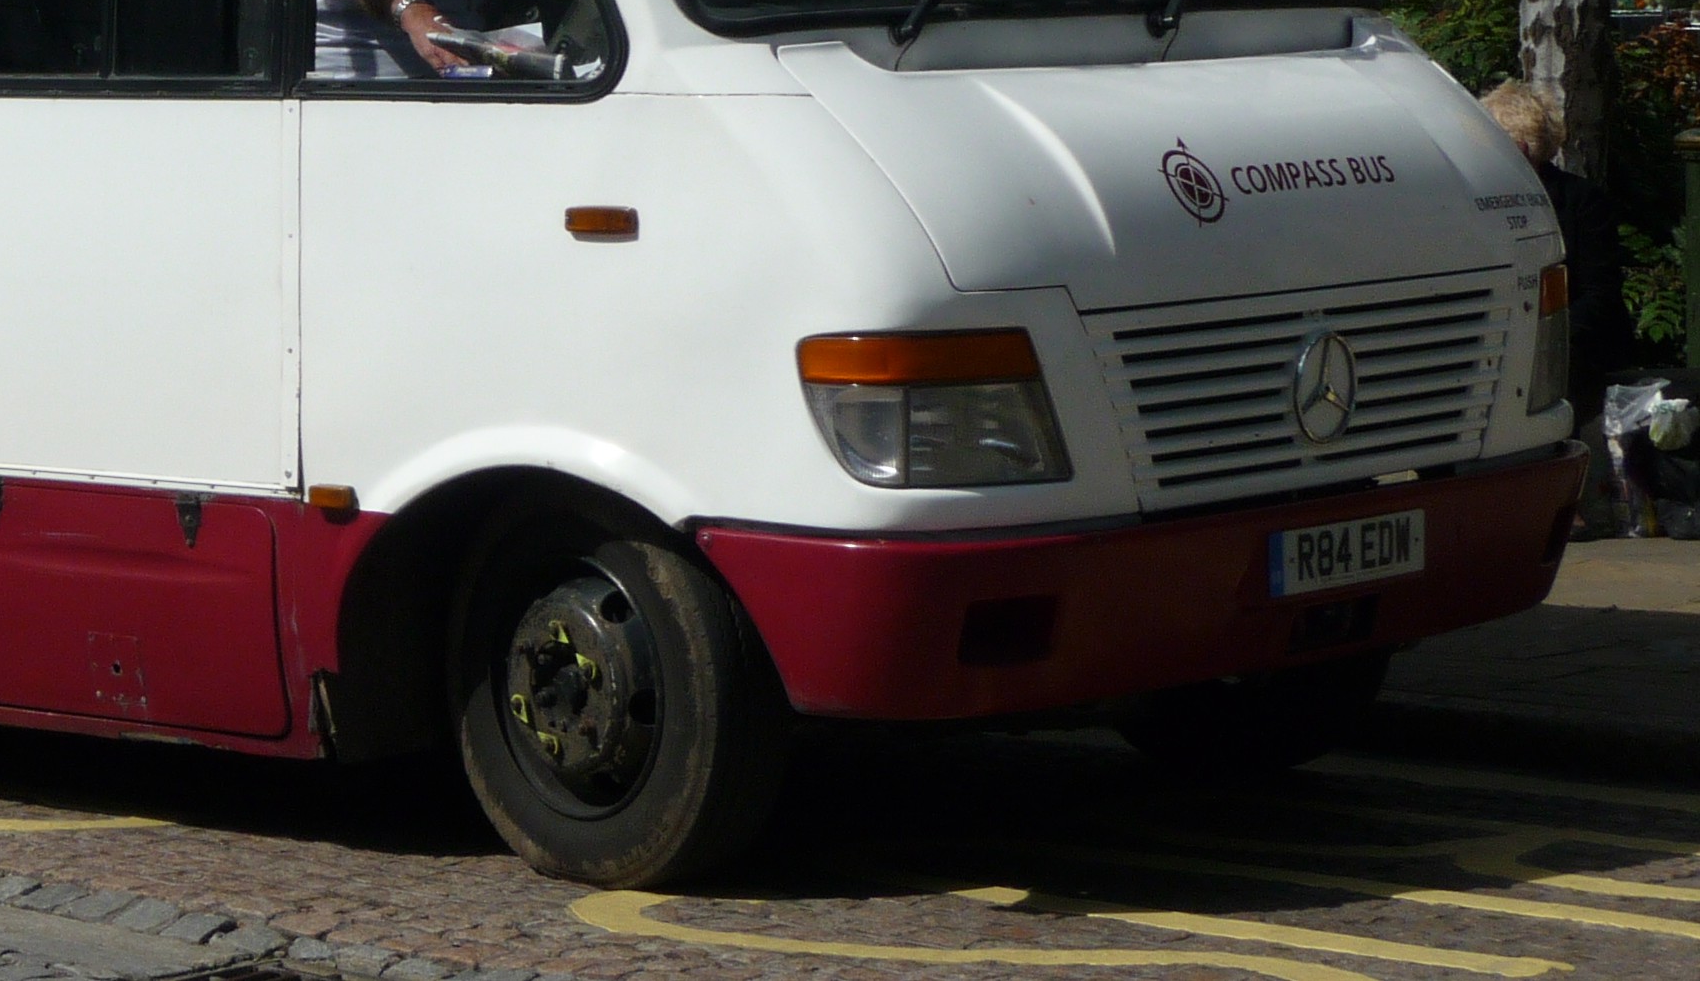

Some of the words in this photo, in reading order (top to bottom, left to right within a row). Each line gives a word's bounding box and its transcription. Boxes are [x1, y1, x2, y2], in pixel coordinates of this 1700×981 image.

[1230, 158, 1348, 195] COMPASS
[1350, 155, 1396, 184] BUS
[1474, 196, 1527, 212] EMERGENCY
[1507, 215, 1528, 230] STOP
[1297, 527, 1353, 582] R84
[1360, 515, 1412, 569] EDW
